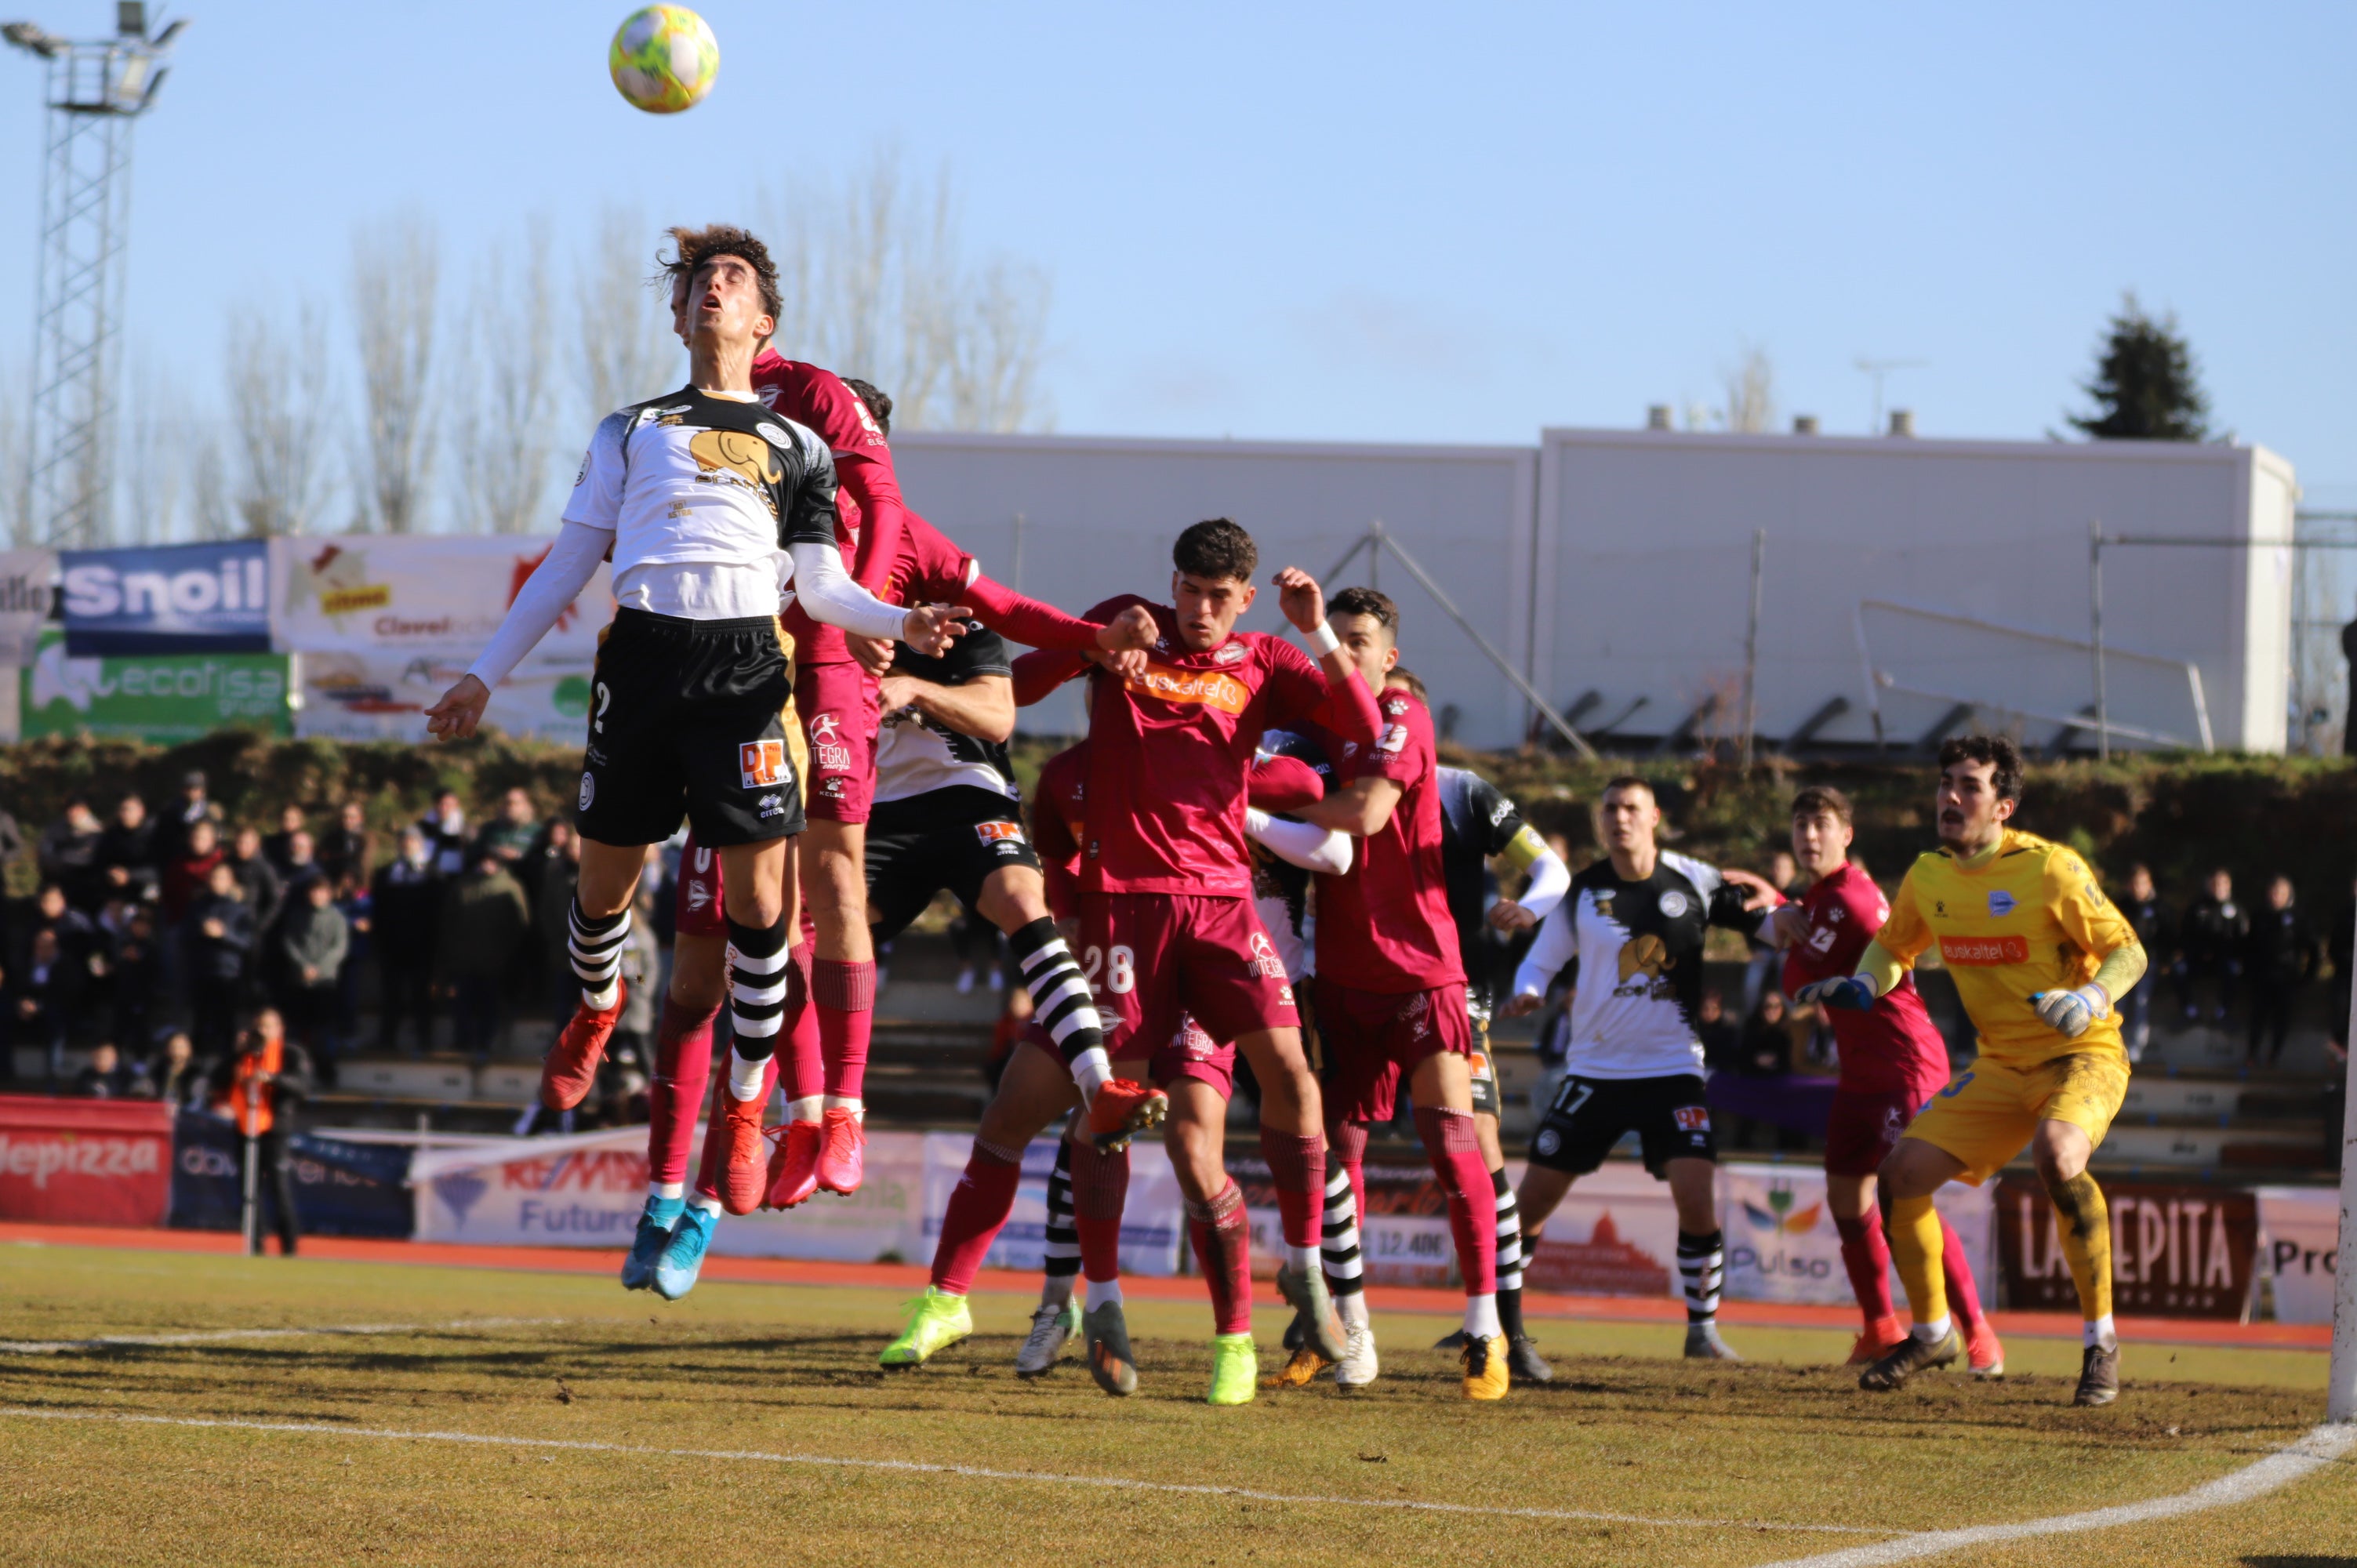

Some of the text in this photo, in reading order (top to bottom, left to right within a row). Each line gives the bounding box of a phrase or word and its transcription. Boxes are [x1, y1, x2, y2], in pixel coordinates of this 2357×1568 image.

[64, 557, 265, 617] Snoil
[819, 790, 846, 799] KELME
[1944, 943, 2004, 960] euskaltel
[1084, 945, 1135, 994] 28
[1555, 1080, 1594, 1115] 17
[2110, 1196, 2233, 1289] EPITA
[1730, 1247, 1831, 1279] Pulso
